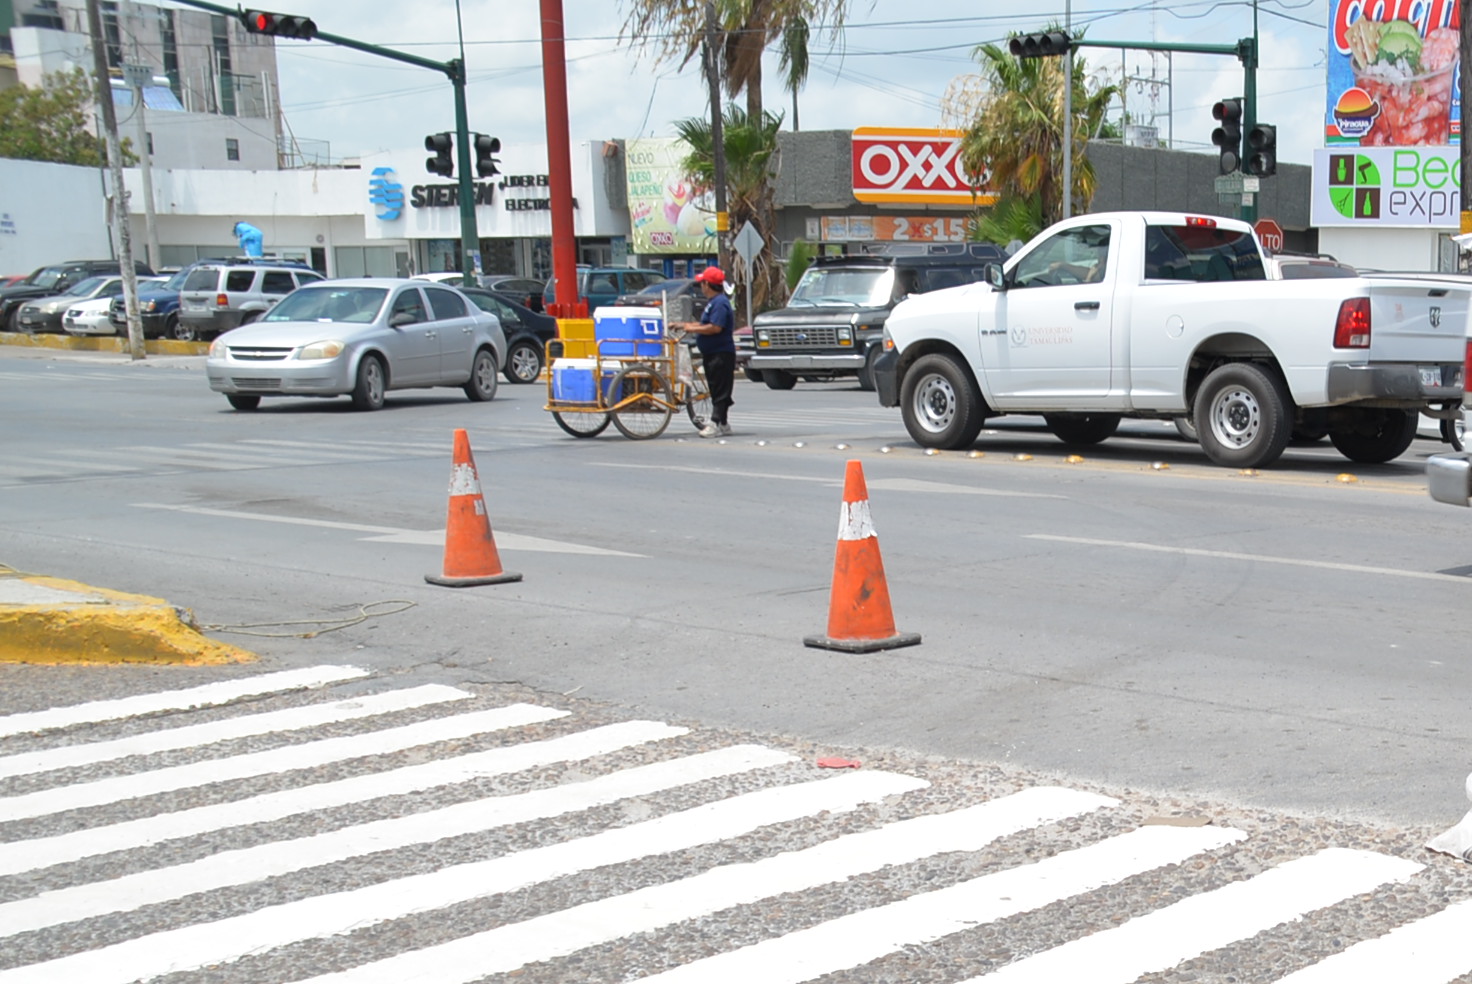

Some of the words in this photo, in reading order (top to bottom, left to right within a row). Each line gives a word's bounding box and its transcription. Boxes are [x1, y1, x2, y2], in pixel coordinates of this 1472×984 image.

[629, 170, 652, 183] QUESO
[860, 141, 993, 191] OXXO
[411, 182, 495, 208] STERN
[1261, 234, 1280, 250] LTO
